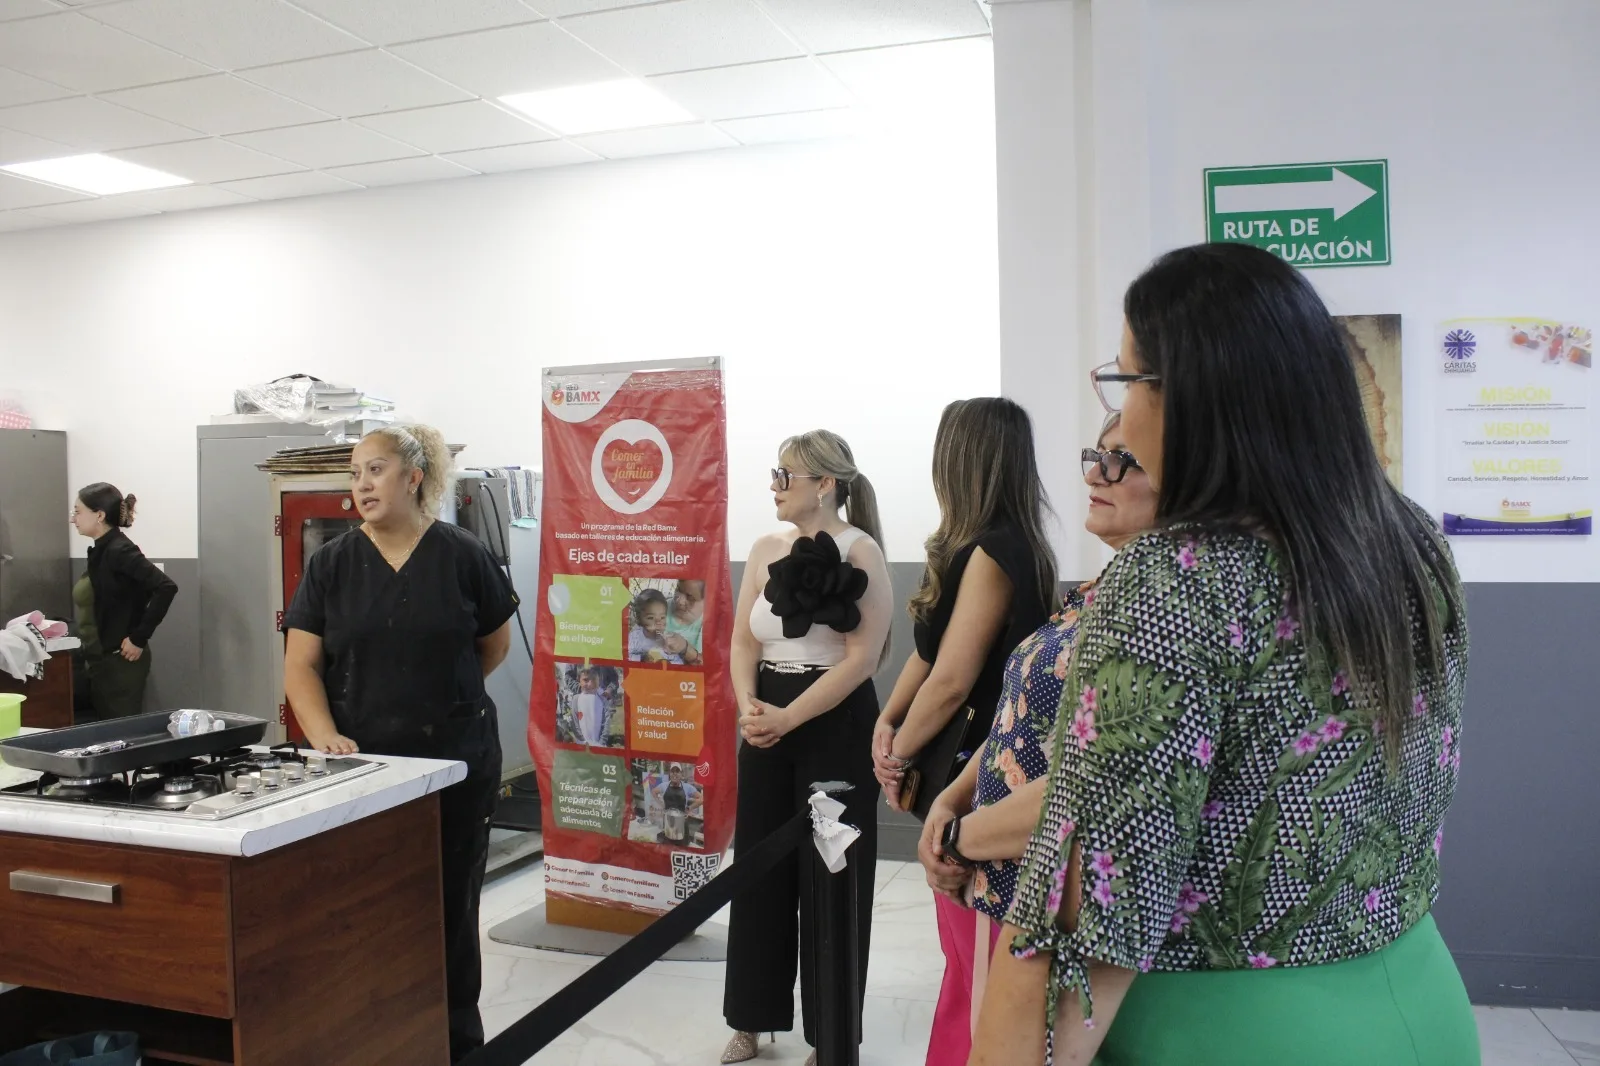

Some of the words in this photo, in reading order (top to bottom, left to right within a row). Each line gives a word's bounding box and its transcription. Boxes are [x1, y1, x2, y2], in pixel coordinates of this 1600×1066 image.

[1223, 219, 1284, 240] RUTA
[1290, 217, 1320, 237] DE
[566, 391, 601, 403] BAMX
[1480, 383, 1553, 401] MISIÓN
[1484, 418, 1552, 437] VISIÓN
[611, 449, 645, 462] Comer
[626, 461, 636, 470] en
[1472, 458, 1563, 474] VALORES
[611, 466, 654, 483] familia
[580, 522, 590, 530] Un
[590, 523, 625, 532] programa
[625, 523, 635, 531] de
[635, 523, 642, 531] la
[589, 533, 616, 541] talleres
[616, 533, 625, 541] de
[625, 534, 662, 542] educación
[568, 548, 595, 565] Ejes
[597, 550, 614, 563] de
[616, 550, 650, 564] cada
[652, 551, 690, 565] taller
[600, 586, 613, 597] 01
[559, 621, 600, 632] Bienestar
[581, 634, 605, 646] hogar
[679, 681, 697, 692] 02
[637, 705, 674, 717] Relación
[637, 717, 695, 730] alimentación
[637, 730, 644, 739] y
[644, 729, 668, 740] salud
[602, 764, 617, 775] 03
[560, 782, 600, 794] Técnicas
[599, 784, 612, 795] de
[559, 795, 613, 807] preparación
[560, 806, 600, 817] adecuada
[601, 807, 613, 819] de
[562, 816, 602, 828] alimentos
